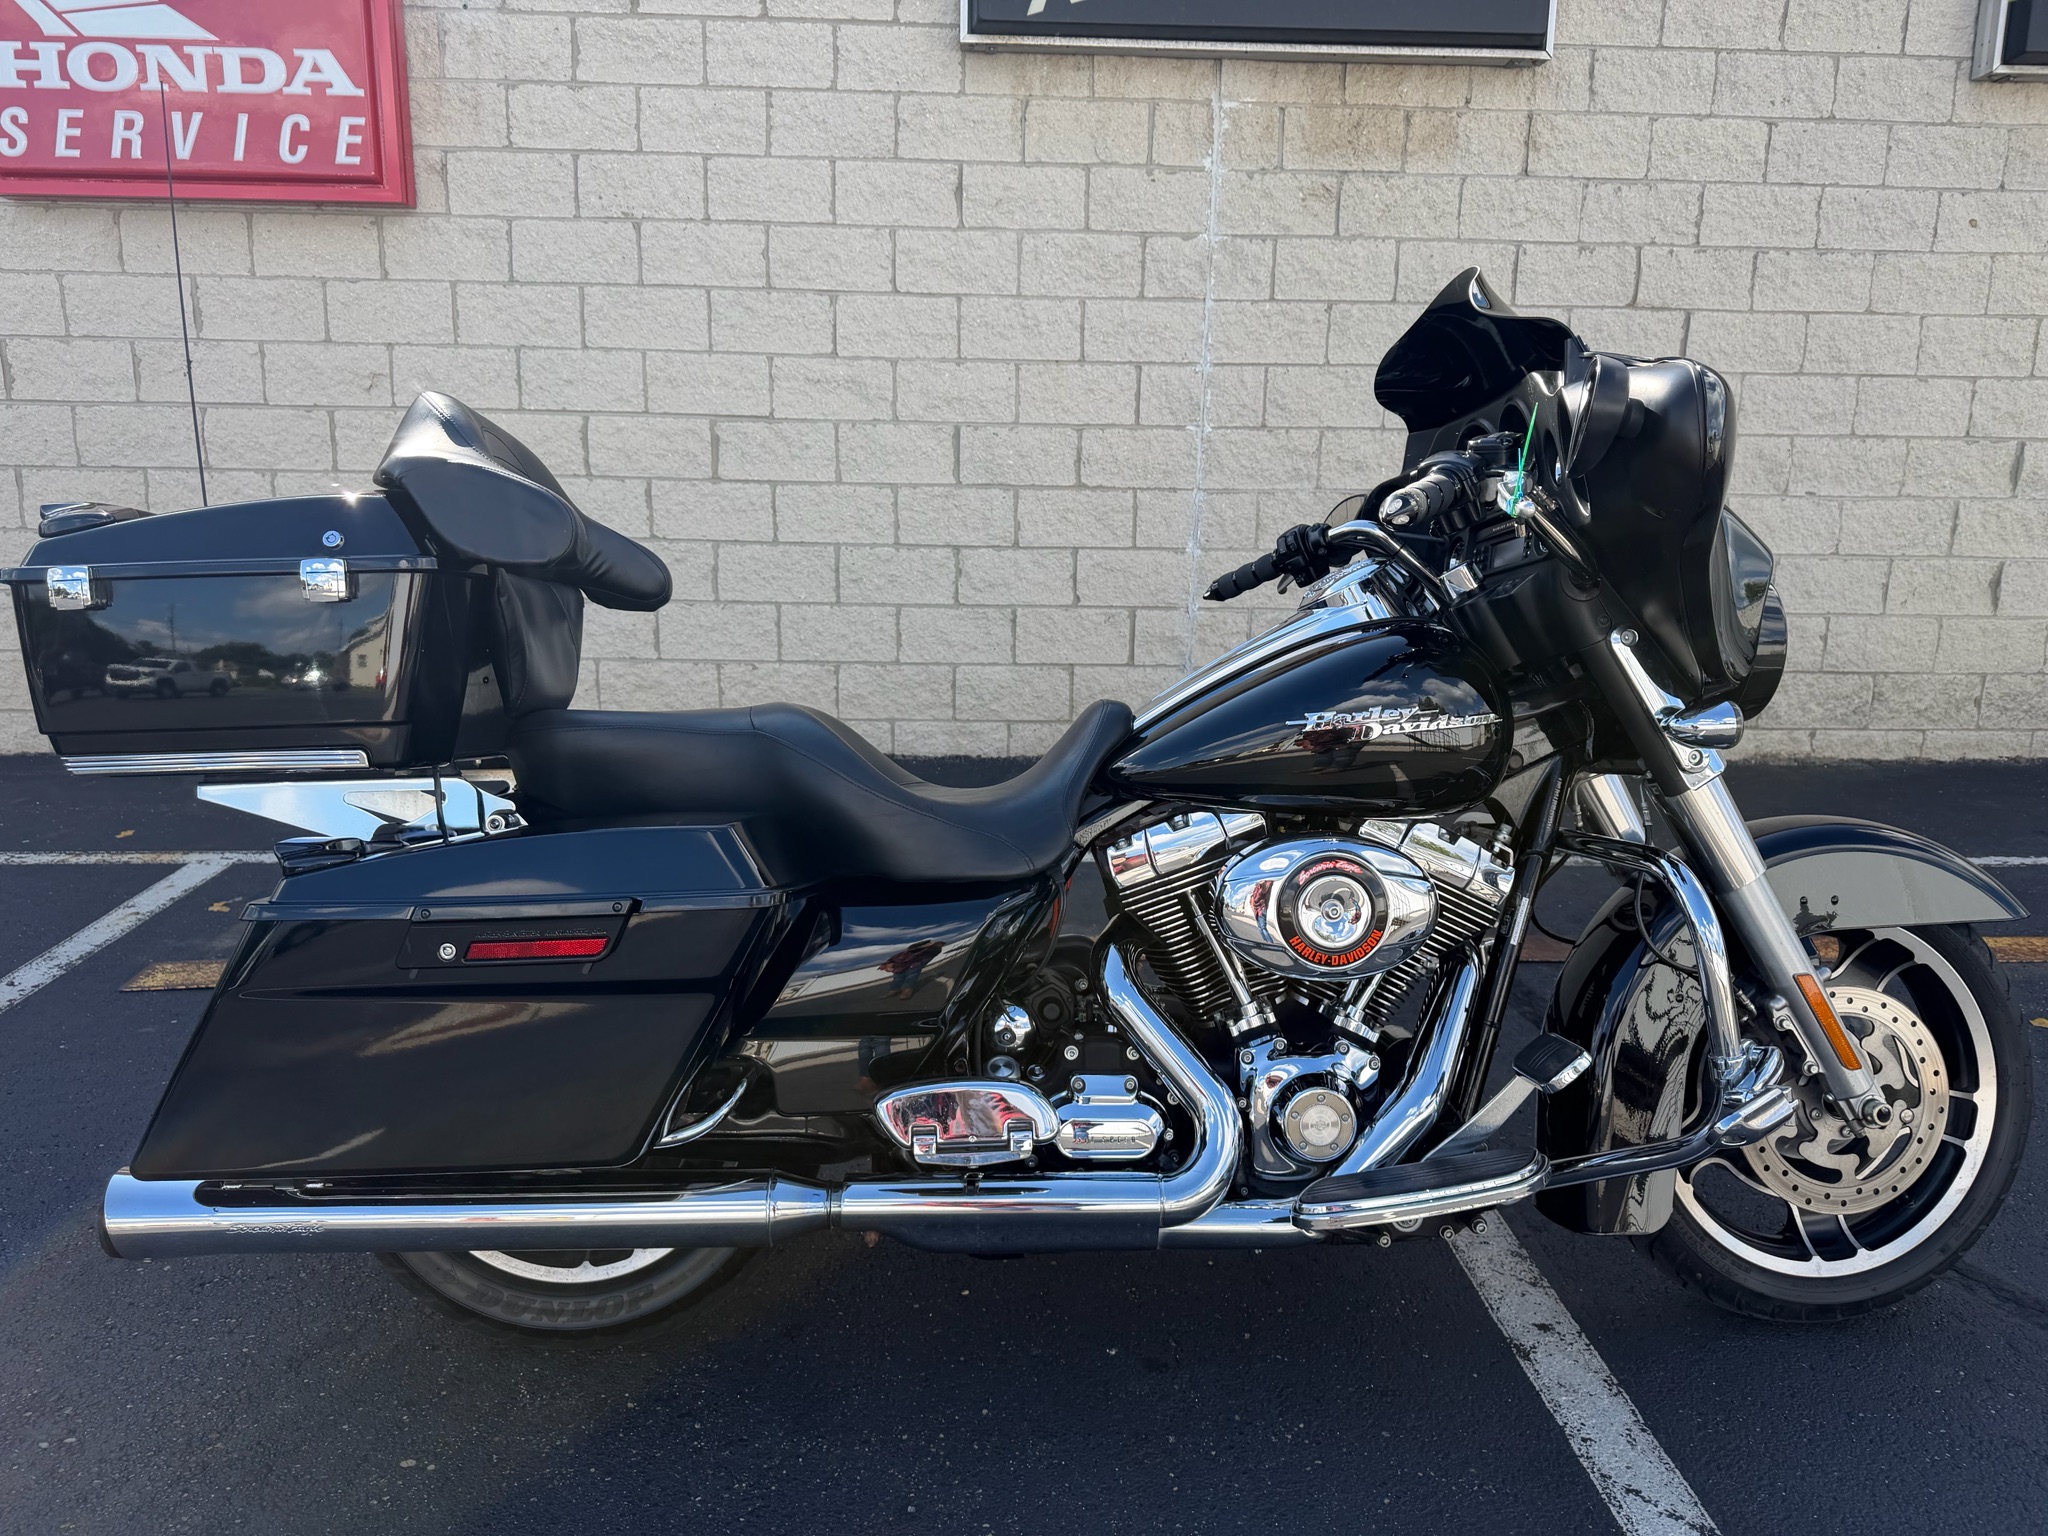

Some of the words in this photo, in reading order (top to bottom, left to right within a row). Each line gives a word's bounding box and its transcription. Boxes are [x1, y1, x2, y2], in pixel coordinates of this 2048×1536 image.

[0, 41, 365, 97] HONDA
[0, 106, 366, 166] SERVICE
[1347, 713, 1503, 743] Davidson
[1289, 929, 1384, 966] HARLEY-DAVIDSON
[465, 1282, 655, 1323] DUNLOP
